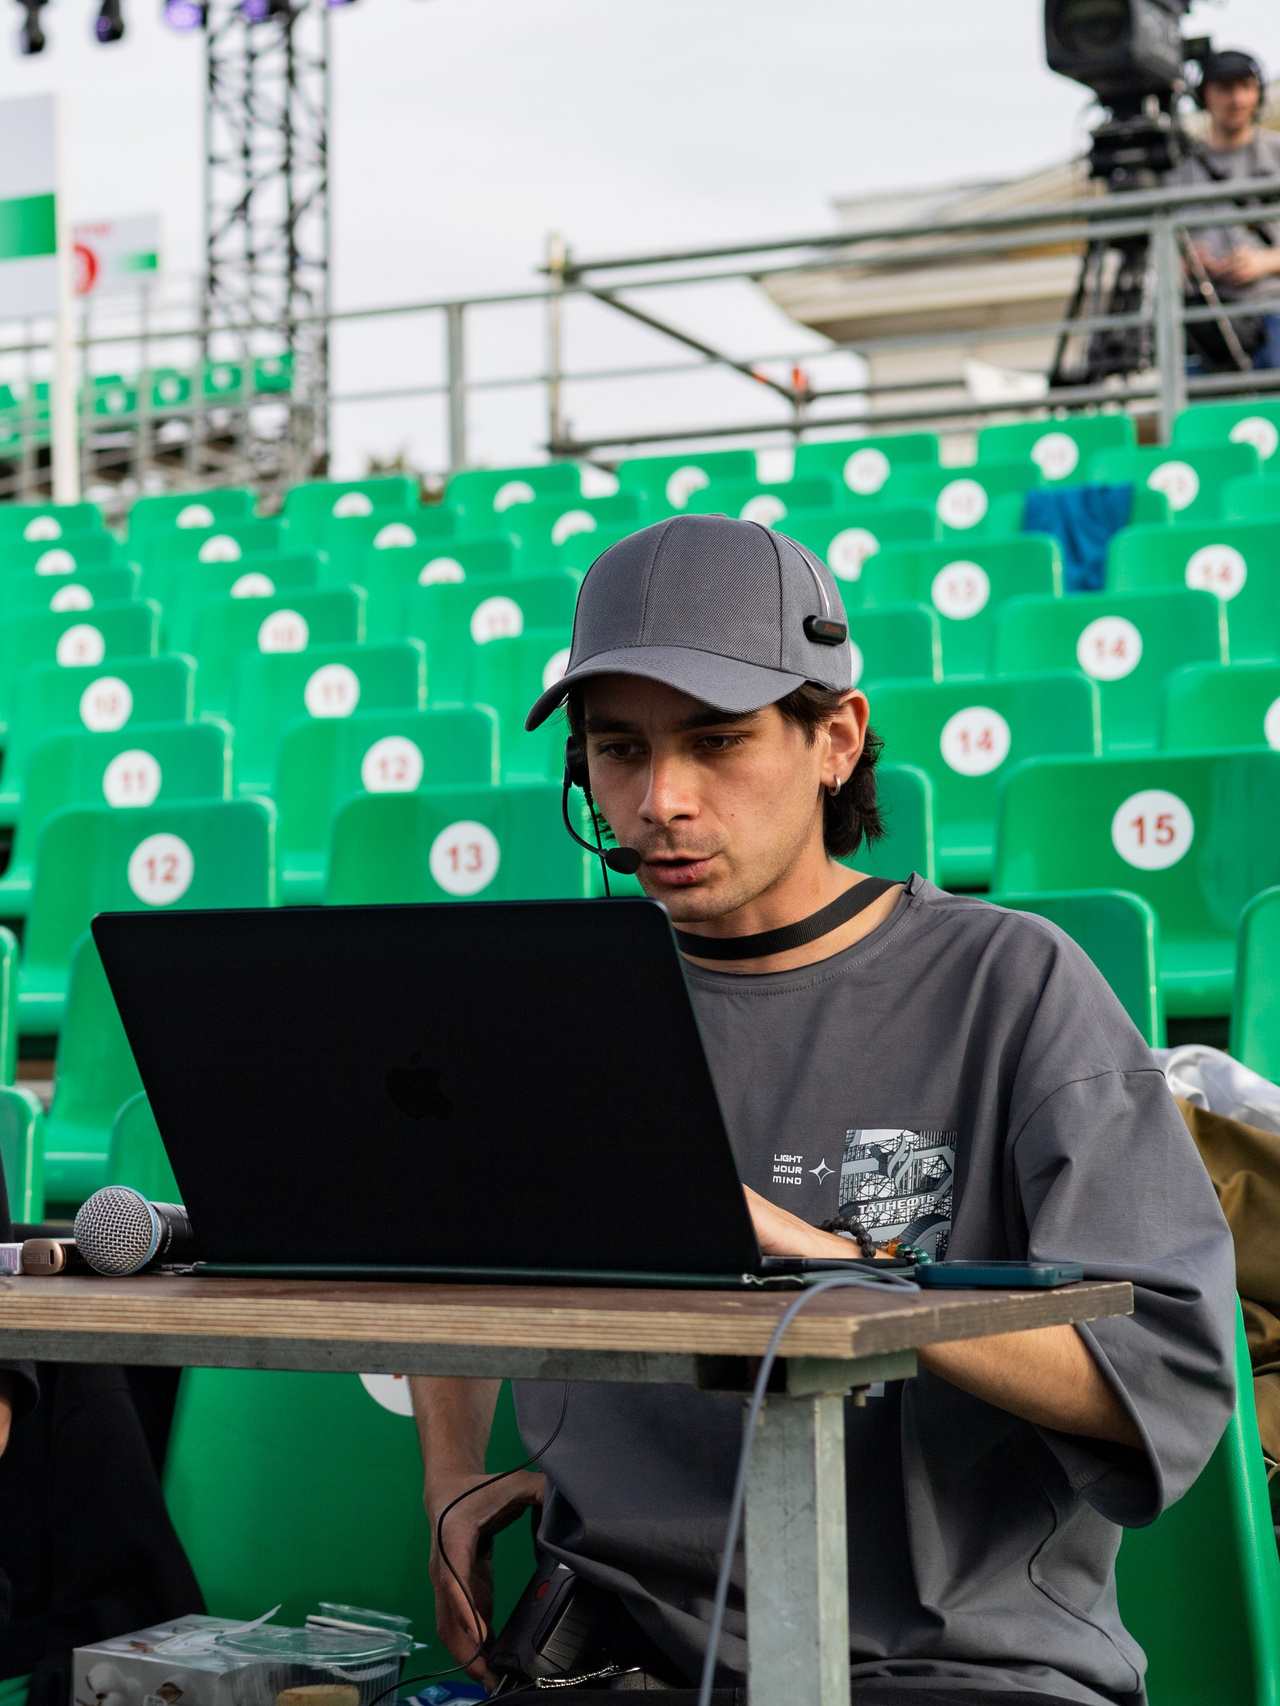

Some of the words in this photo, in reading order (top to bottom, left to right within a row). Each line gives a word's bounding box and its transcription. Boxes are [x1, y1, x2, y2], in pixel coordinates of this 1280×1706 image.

[1095, 636, 1127, 661] 14
[960, 728, 993, 755] 14
[120, 767, 147, 793] 11
[378, 755, 409, 782] 12
[1131, 813, 1176, 847] 15
[144, 853, 179, 884] 12
[446, 842, 484, 874] 13
[773, 1164, 802, 1174] YOUR
[774, 1154, 803, 1163] LIGHT
[773, 1175, 801, 1185] MIND
[858, 1194, 935, 1214] ТАТНЕФТЬ
